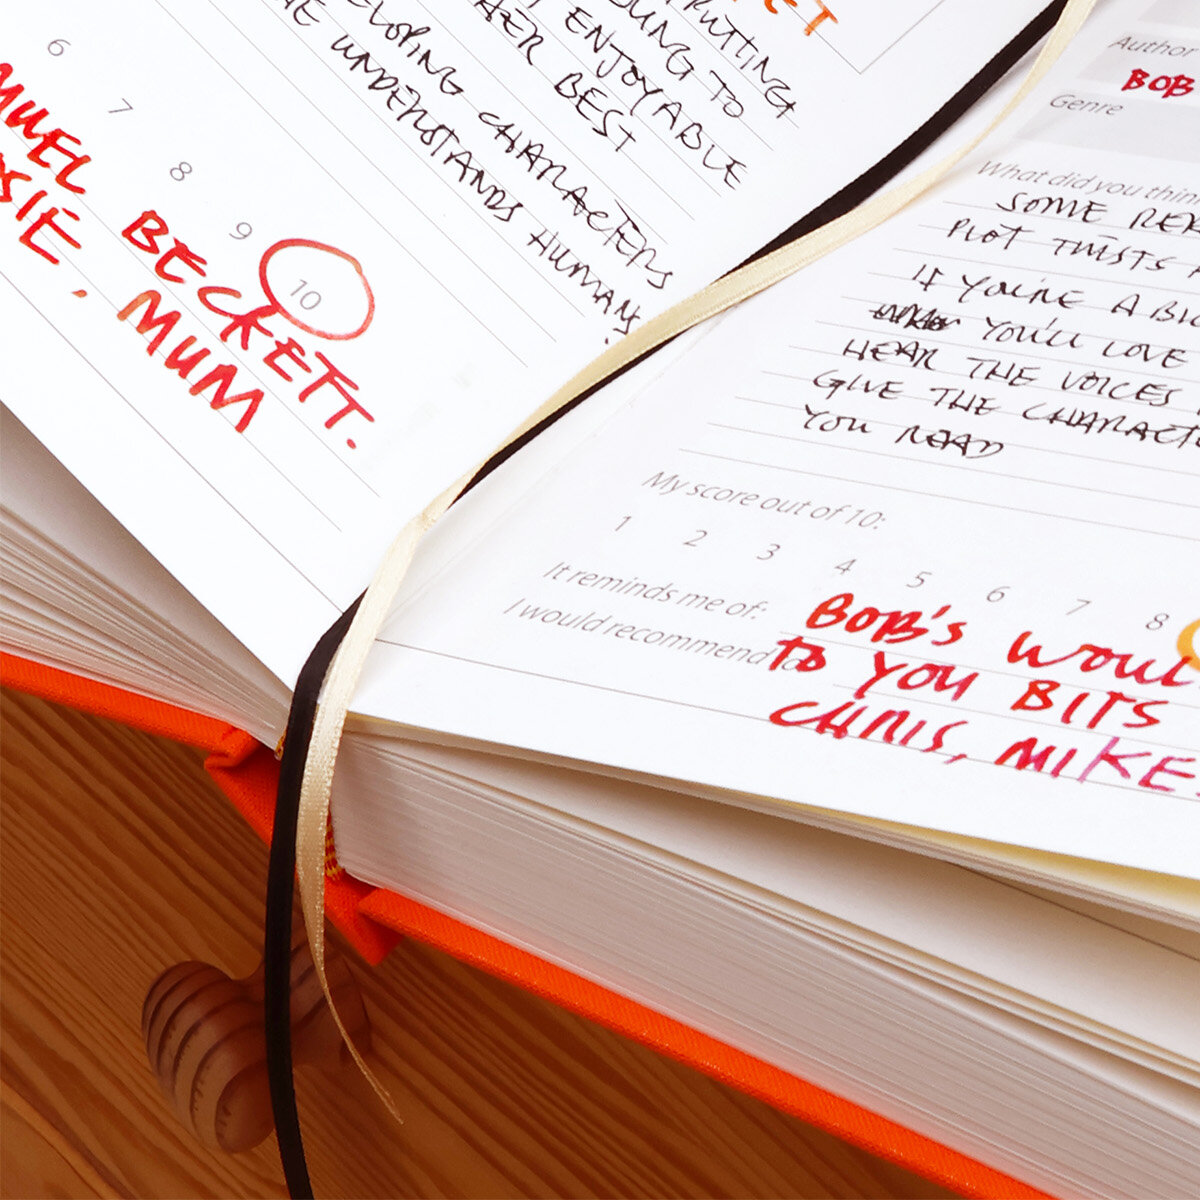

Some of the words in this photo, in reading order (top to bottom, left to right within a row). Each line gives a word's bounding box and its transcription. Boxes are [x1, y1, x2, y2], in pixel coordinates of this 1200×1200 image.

[1109, 35, 1199, 58] Author
[709, 69, 744, 118] TO
[1121, 67, 1196, 98] BOB
[554, 72, 636, 153] BEST
[1050, 94, 1124, 116] Genre
[47, 38, 72, 57] 6
[169, 160, 194, 182] 8
[228, 221, 253, 241] 9
[290, 278, 323, 311] 10
[977, 160, 1049, 184] What
[1048, 170, 1097, 189] did
[996, 192, 1107, 224] SOME
[947, 218, 1035, 250] PLOT
[1110, 294, 1142, 318] A
[117, 289, 265, 434] MUM
[843, 338, 939, 371] HEAR
[967, 357, 1041, 387] THE
[1061, 371, 1183, 407] VOICES
[1102, 340, 1189, 368] LOVE
[813, 369, 904, 400] GIVE
[930, 387, 1001, 415] THE
[802, 404, 872, 434] YOU
[641, 471, 686, 495] My
[686, 481, 759, 506] score
[760, 495, 810, 516] out
[566, 568, 680, 604] reminds
[677, 591, 726, 612] me
[683, 529, 708, 547] 2
[756, 543, 781, 561] 3
[833, 558, 857, 576] 4
[906, 570, 932, 589] 5
[986, 585, 1010, 603] 6
[1145, 612, 1170, 631] 8
[519, 604, 612, 633] would
[604, 621, 777, 666] recommend
[853, 651, 979, 702] YOU
[1010, 679, 1170, 730] BITS
